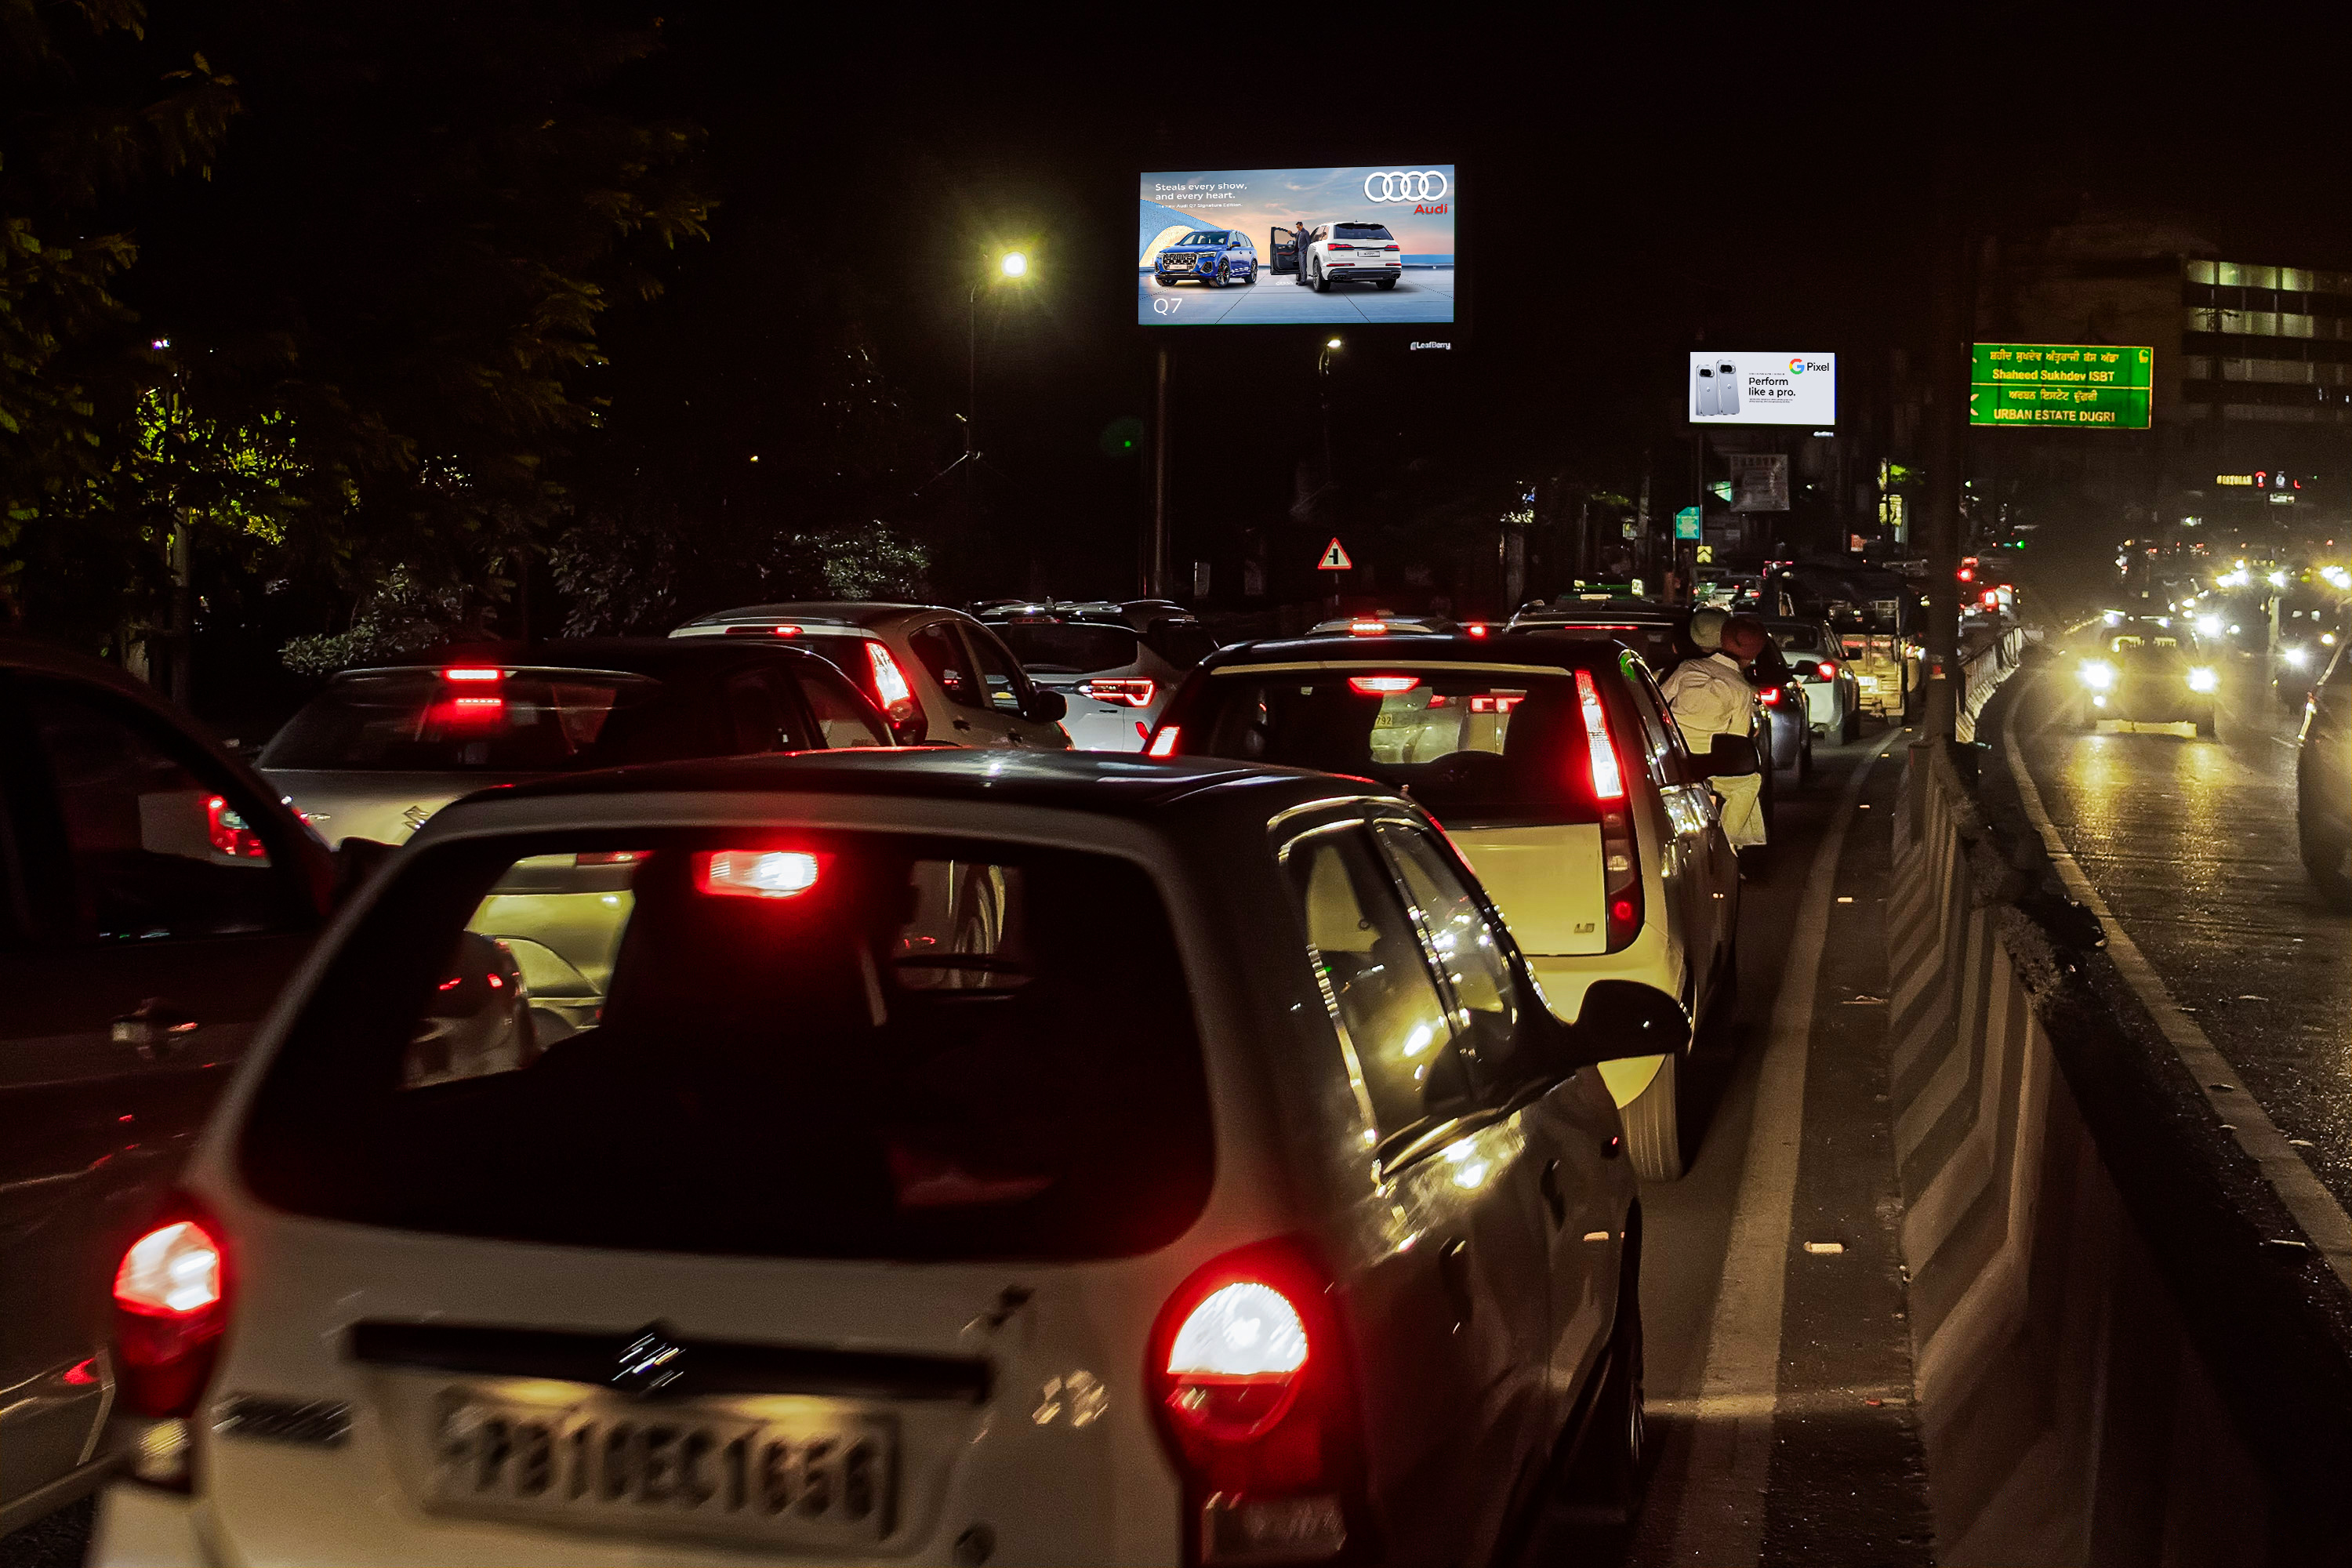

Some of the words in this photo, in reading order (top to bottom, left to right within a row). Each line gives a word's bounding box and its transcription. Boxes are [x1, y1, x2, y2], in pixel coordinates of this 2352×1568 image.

[1155, 183, 1185, 191] Steals
[1218, 182, 1247, 191] show,
[1414, 203, 1448, 214] Audi
[1153, 298, 1183, 316] Q7
[1416, 341, 1451, 350] LeafBerry
[1806, 361, 1830, 372] Pixel
[1992, 368, 2038, 380] Shaheed
[2040, 369, 2086, 382] Sukhdev
[2089, 371, 2115, 382] ISBT
[1748, 377, 1789, 386] Perform
[1748, 387, 1766, 396] like
[1994, 408, 2032, 420] URBAN
[2034, 409, 2076, 421] ESTATE
[2079, 411, 2115, 423] DUGRI
